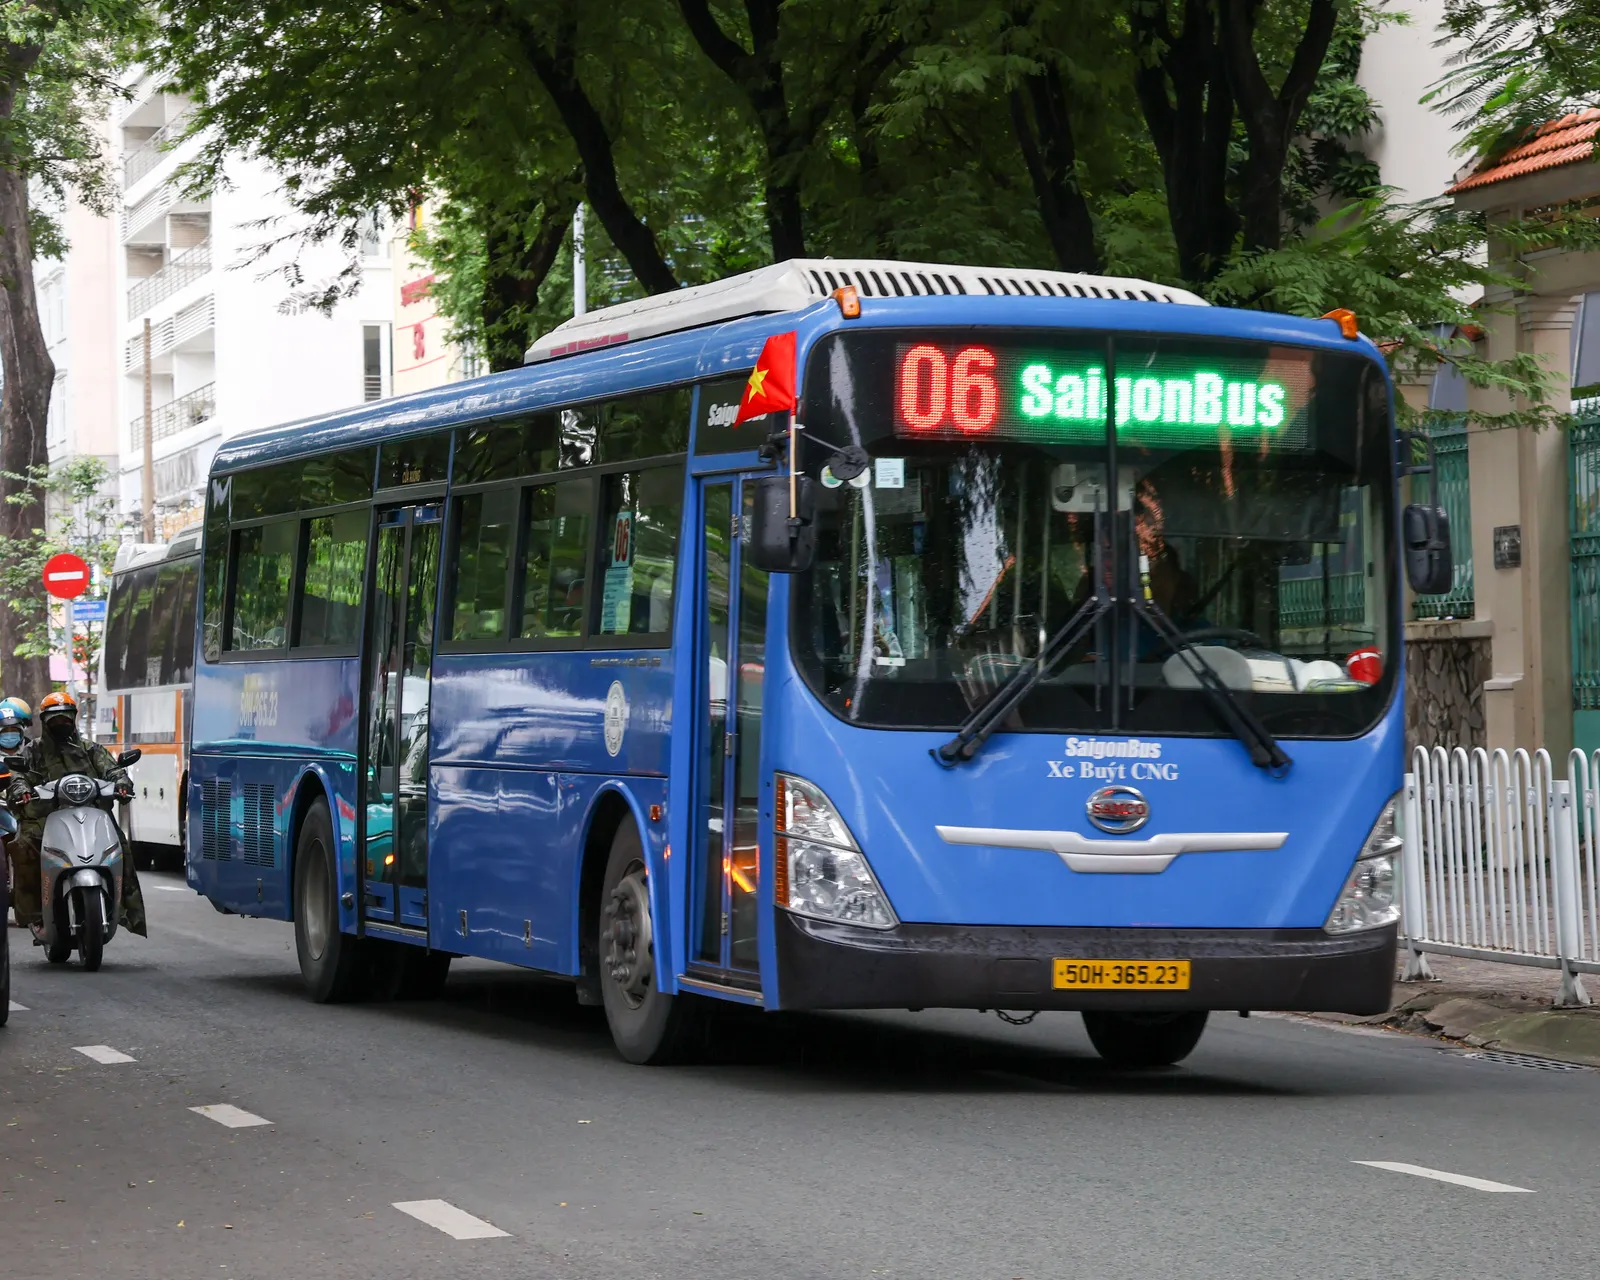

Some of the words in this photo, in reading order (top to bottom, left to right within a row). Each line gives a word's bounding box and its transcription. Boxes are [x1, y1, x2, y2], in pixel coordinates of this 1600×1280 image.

[901, 345, 997, 430] 06
[614, 517, 630, 563] 06
[1065, 737, 1162, 759] SaigonBus
[1046, 760, 1076, 778] Xe
[1079, 761, 1127, 783] Buýt
[1130, 762, 1180, 780] CNG
